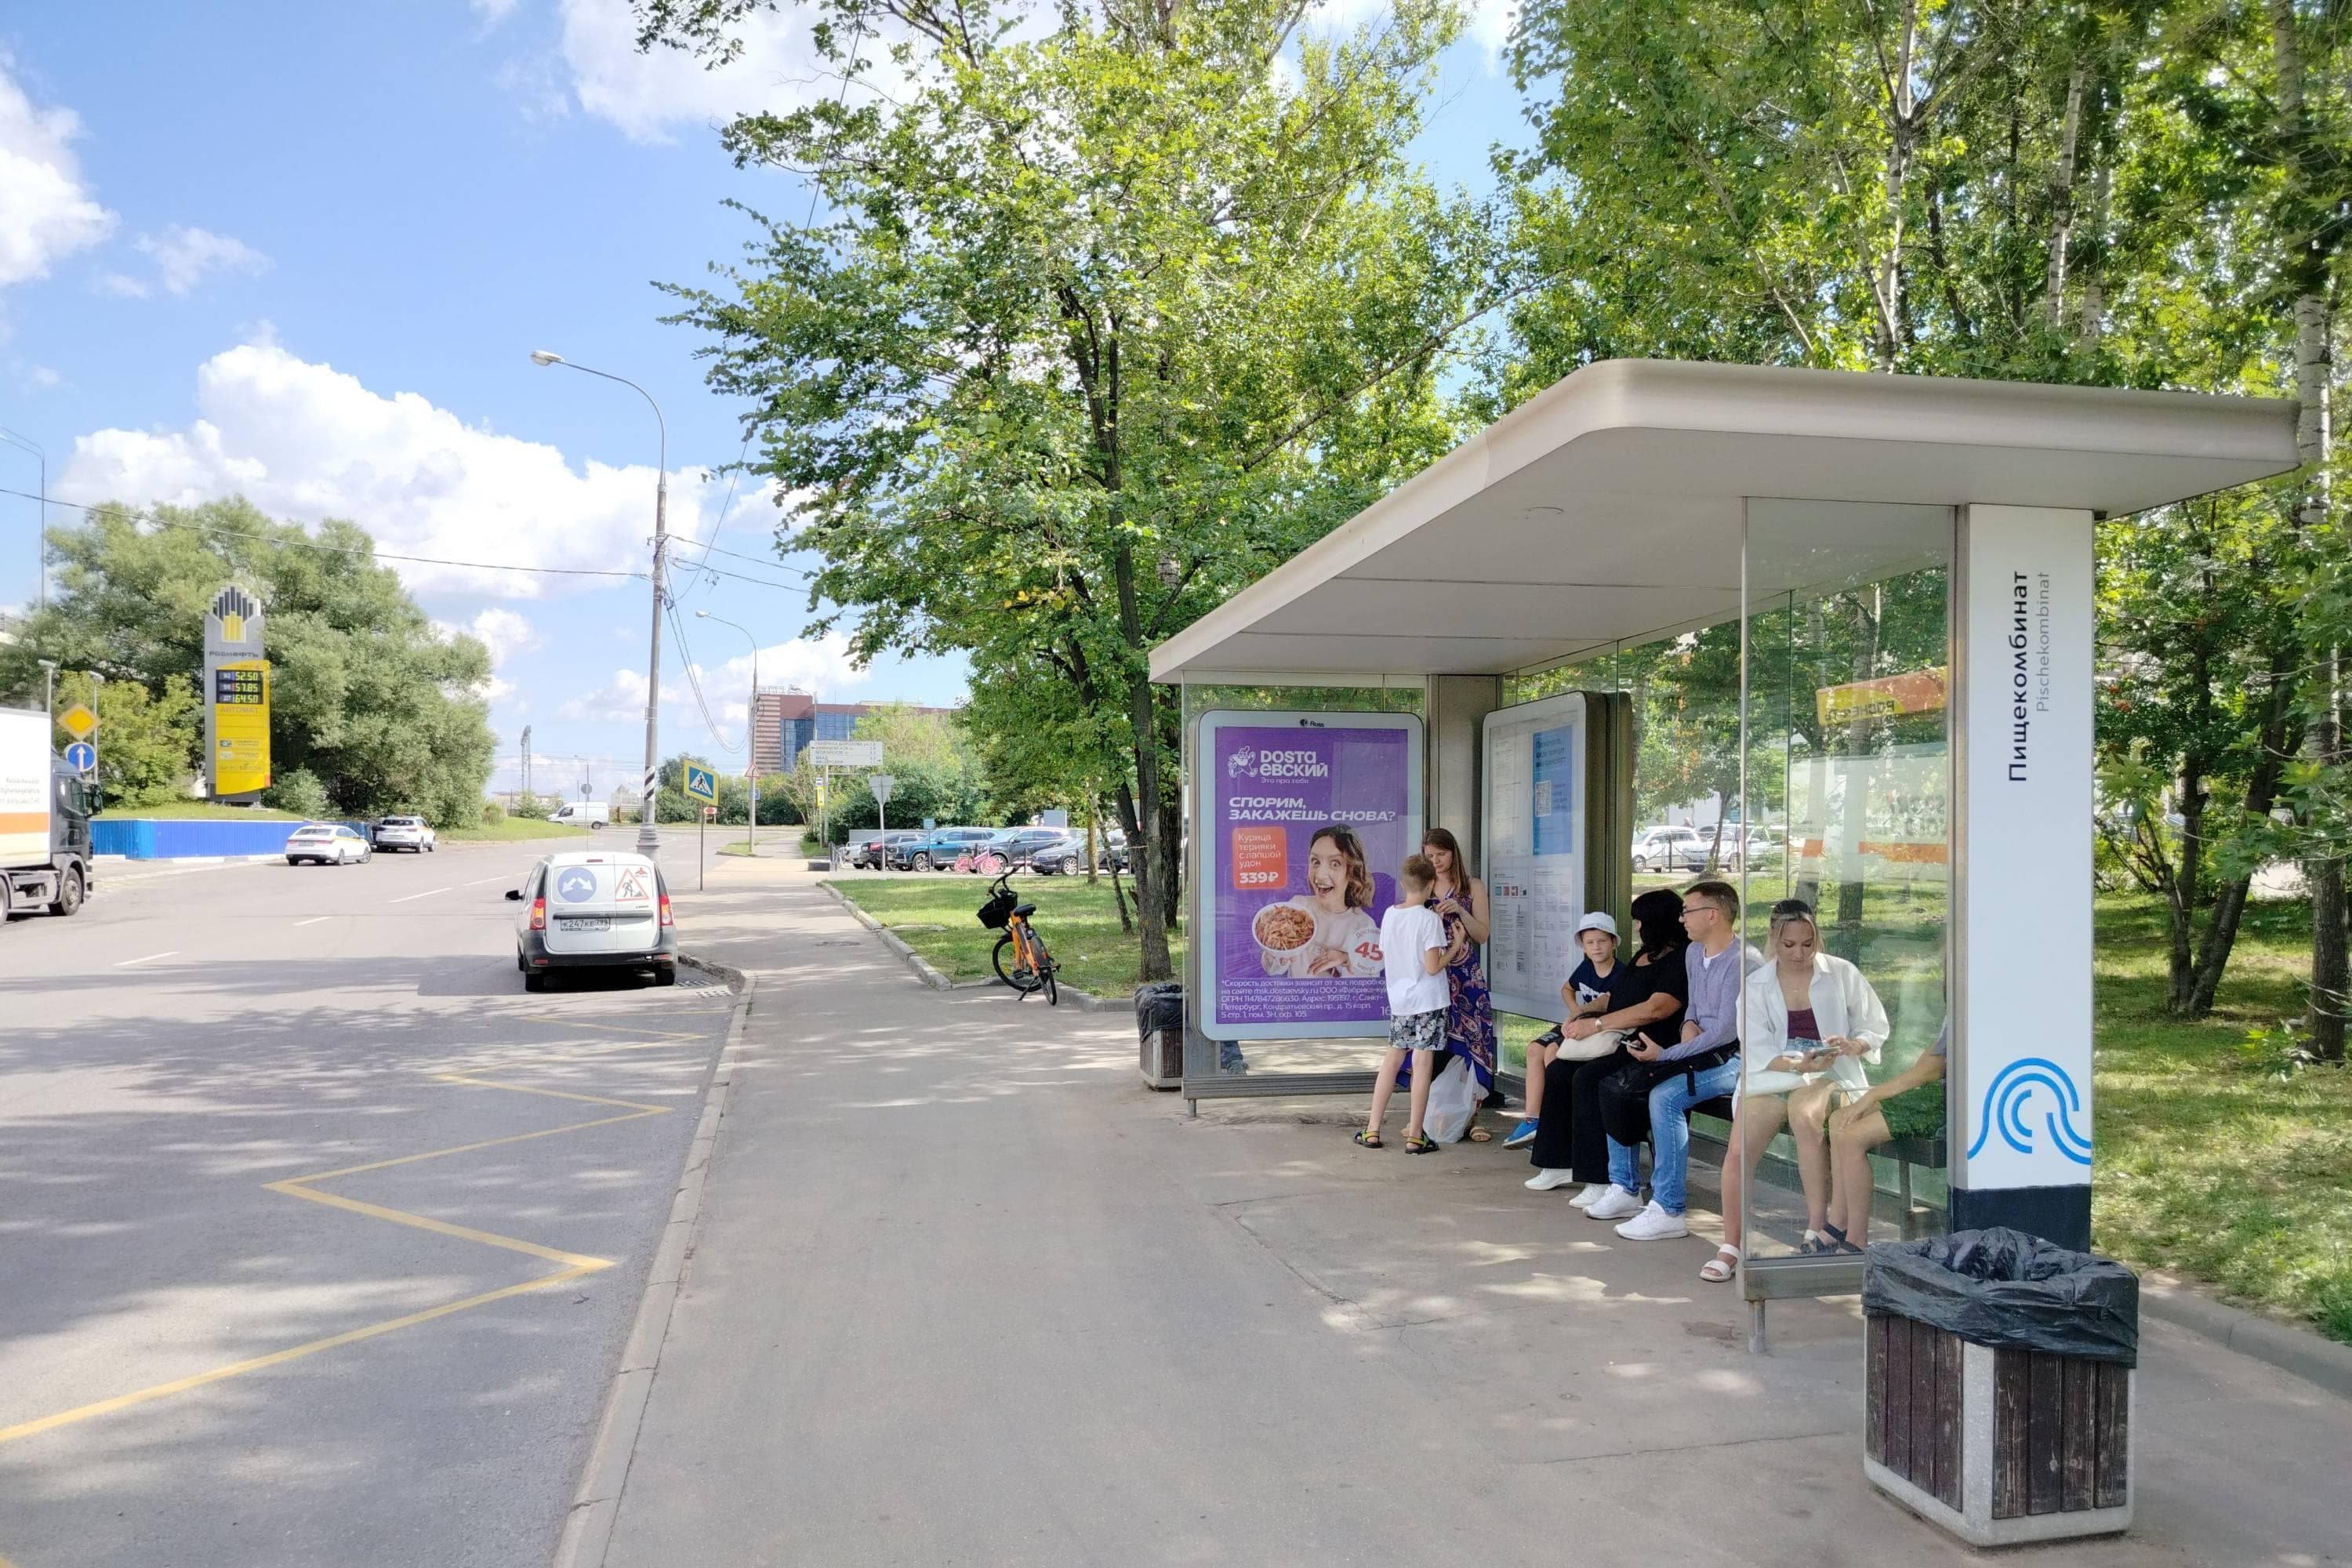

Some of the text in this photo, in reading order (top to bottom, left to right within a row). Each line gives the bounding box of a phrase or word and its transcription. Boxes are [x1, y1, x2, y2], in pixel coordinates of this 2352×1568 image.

[2036, 572, 2050, 712] Pischekombinat
[2008, 571, 2030, 781] Пищекомбинат
[1229, 797, 1307, 810] СПОРИМ,
[1229, 809, 1396, 822] ЗАКАЖЕШЬ СНОВА?
[1239, 833, 1272, 843] Курица
[1239, 844, 1276, 852] терияки
[1246, 851, 1282, 859] лапшой
[1239, 860, 1262, 869] удон
[1354, 942, 1384, 961] 45
[1263, 1003, 1323, 1011] Кондратьевский
